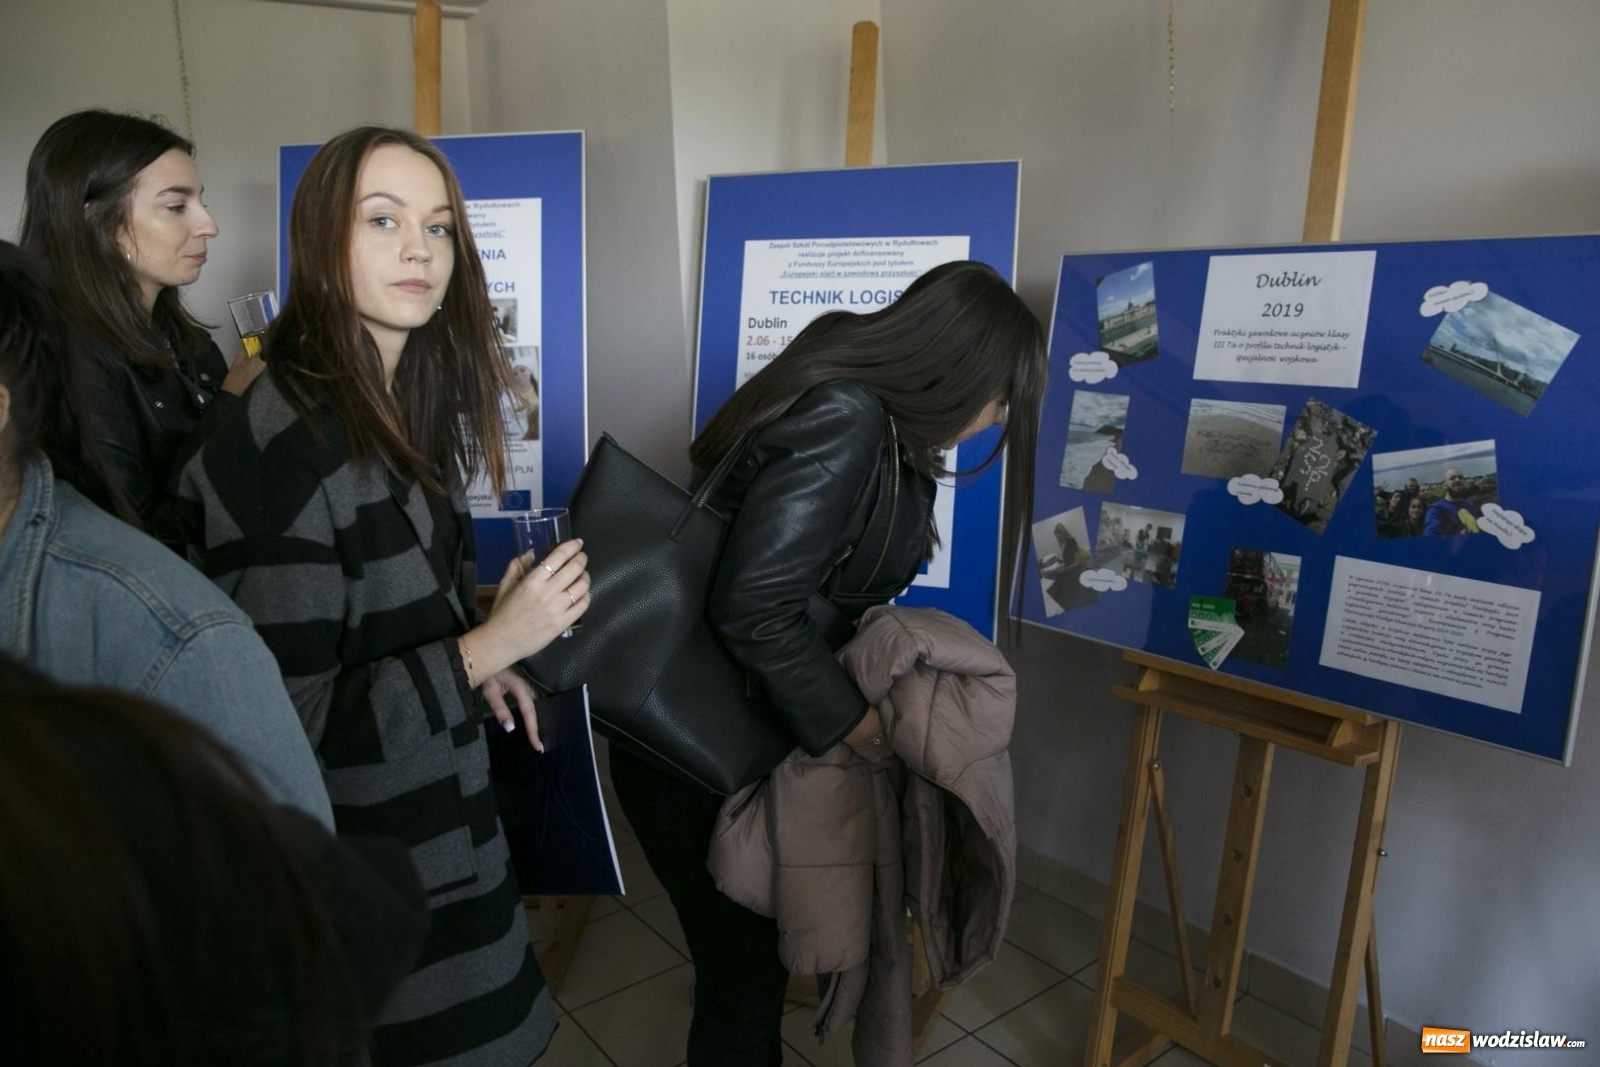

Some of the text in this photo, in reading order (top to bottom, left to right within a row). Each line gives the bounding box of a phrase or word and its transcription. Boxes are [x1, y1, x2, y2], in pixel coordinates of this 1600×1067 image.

[1256, 271, 1322, 289] Dublin
[770, 290, 903, 305] TECHNIK LOGIS
[1262, 302, 1304, 317] 2019
[748, 317, 788, 329] Dublin
[746, 335, 770, 346] 2.06
[1213, 329, 1246, 338] Praktyki
[1327, 330, 1351, 340] klasy
[515, 466, 534, 474] PLN
